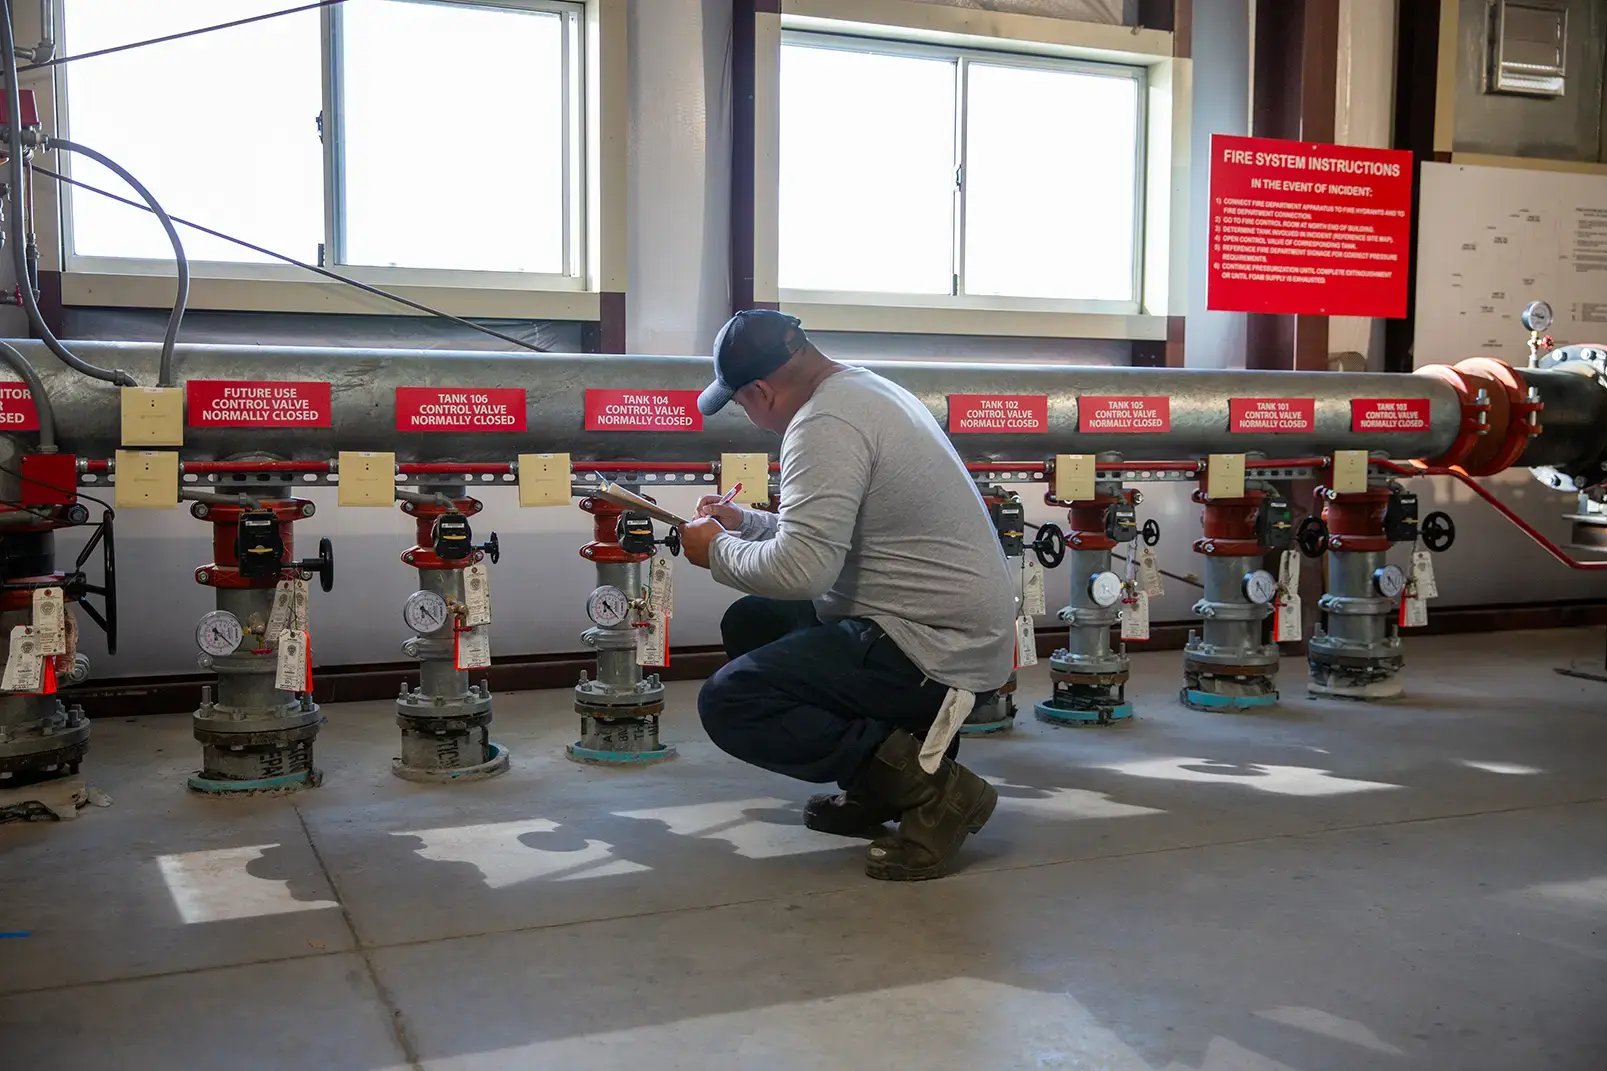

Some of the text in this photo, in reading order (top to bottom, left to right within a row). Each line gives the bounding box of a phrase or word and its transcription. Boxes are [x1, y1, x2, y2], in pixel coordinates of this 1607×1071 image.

[1224, 149, 1400, 177] FIRE SYSTEM INSTRUCTIONS
[1252, 179, 1373, 197] IN THE EVENT OF INCIDENT:
[1223, 198, 1252, 206] CONNECT
[1265, 201, 1301, 210] DEPARTMENT
[1223, 207, 1236, 215] FIRE
[1255, 219, 1282, 227] CONTROL
[1223, 235, 1239, 243] OPEN
[224, 388, 297, 398] FUTURE USE
[438, 394, 488, 403] TANK 106
[623, 395, 668, 404] TANK 104
[212, 399, 309, 409] CONTROL VALVE
[980, 401, 1018, 409] TANK 102
[1108, 401, 1144, 409] TANK 105
[1396, 403, 1407, 411] 103
[419, 405, 506, 414] CONTROL VALVE
[605, 405, 685, 415] CONTROL VALVE
[967, 409, 1033, 419] CONTROL VALVE
[202, 410, 319, 420] NORMALLY CLOSED
[1095, 410, 1156, 419] CONTROL VALVE
[1244, 411, 1301, 420] CONTROL VALVE
[1365, 411, 1418, 419] CONTROL VALVE
[411, 415, 515, 425] NORMALLY CLOSED
[597, 415, 692, 425] NORMALLY CLOSED
[960, 419, 1039, 428] NORMALLY CLOSED
[1089, 419, 1162, 428] NORMALLY CLOSED
[1240, 420, 1307, 428] NORMALLY CLOSED
[1361, 420, 1396, 428] NORMALLY
